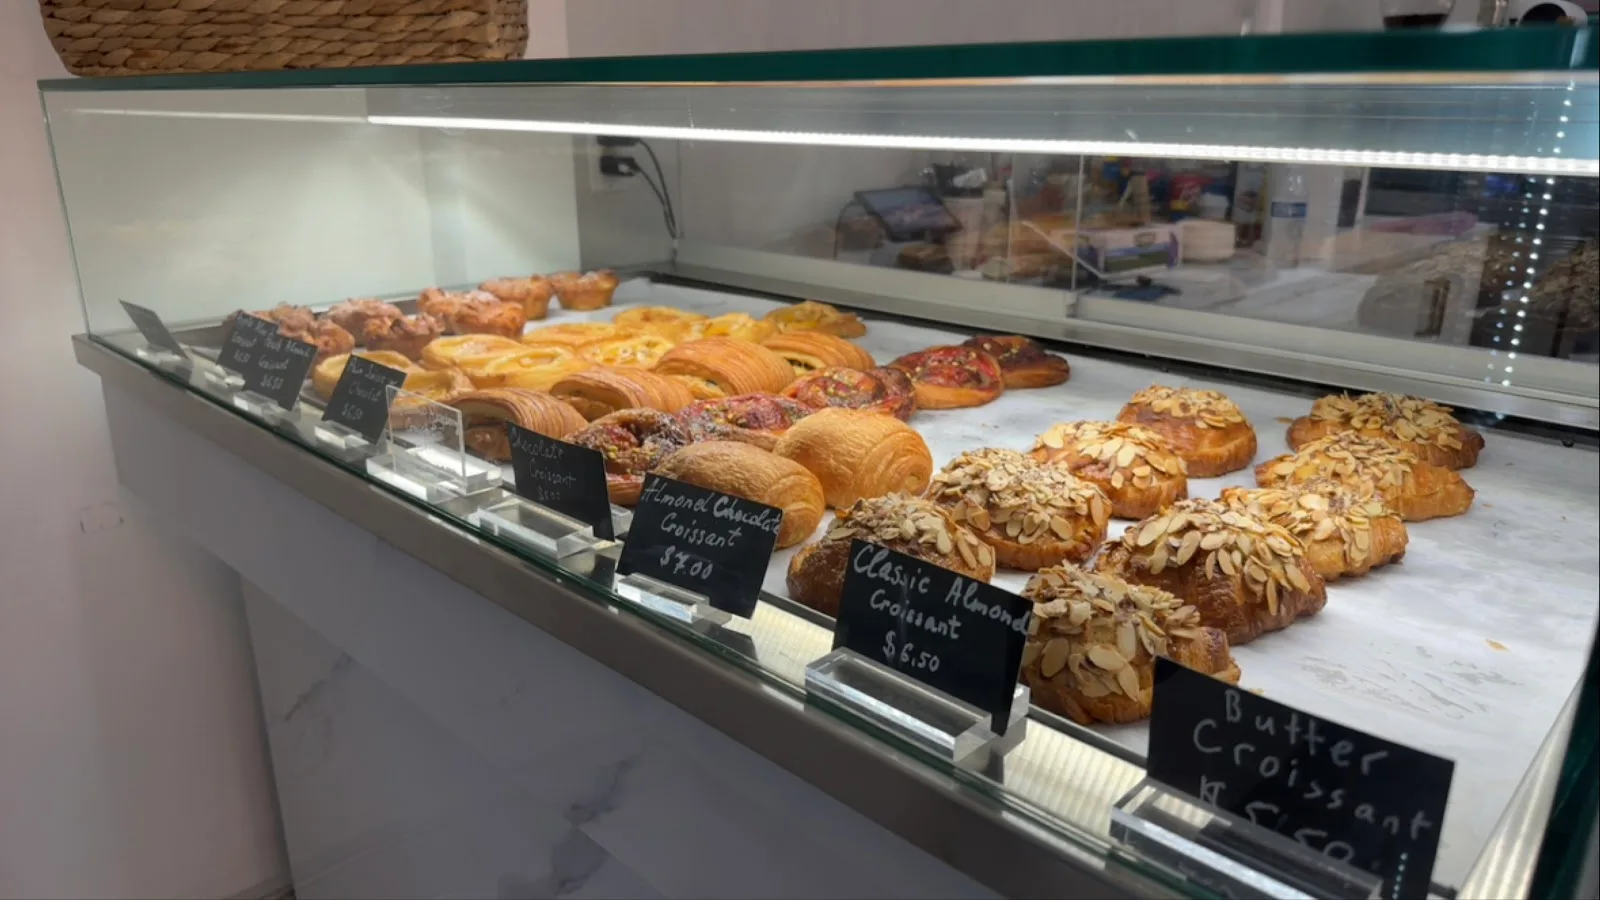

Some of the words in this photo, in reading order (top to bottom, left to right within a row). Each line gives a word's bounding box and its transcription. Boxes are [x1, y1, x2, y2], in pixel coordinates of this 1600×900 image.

[641, 477, 715, 513] Almond
[660, 512, 742, 548] Croissant
[660, 545, 714, 579] $7.00
[853, 544, 930, 594] Classic
[945, 576, 1031, 636] Almond
[869, 589, 962, 640] Croissant
[1224, 689, 1388, 776] Butter
[1193, 719, 1432, 840] Croissant
